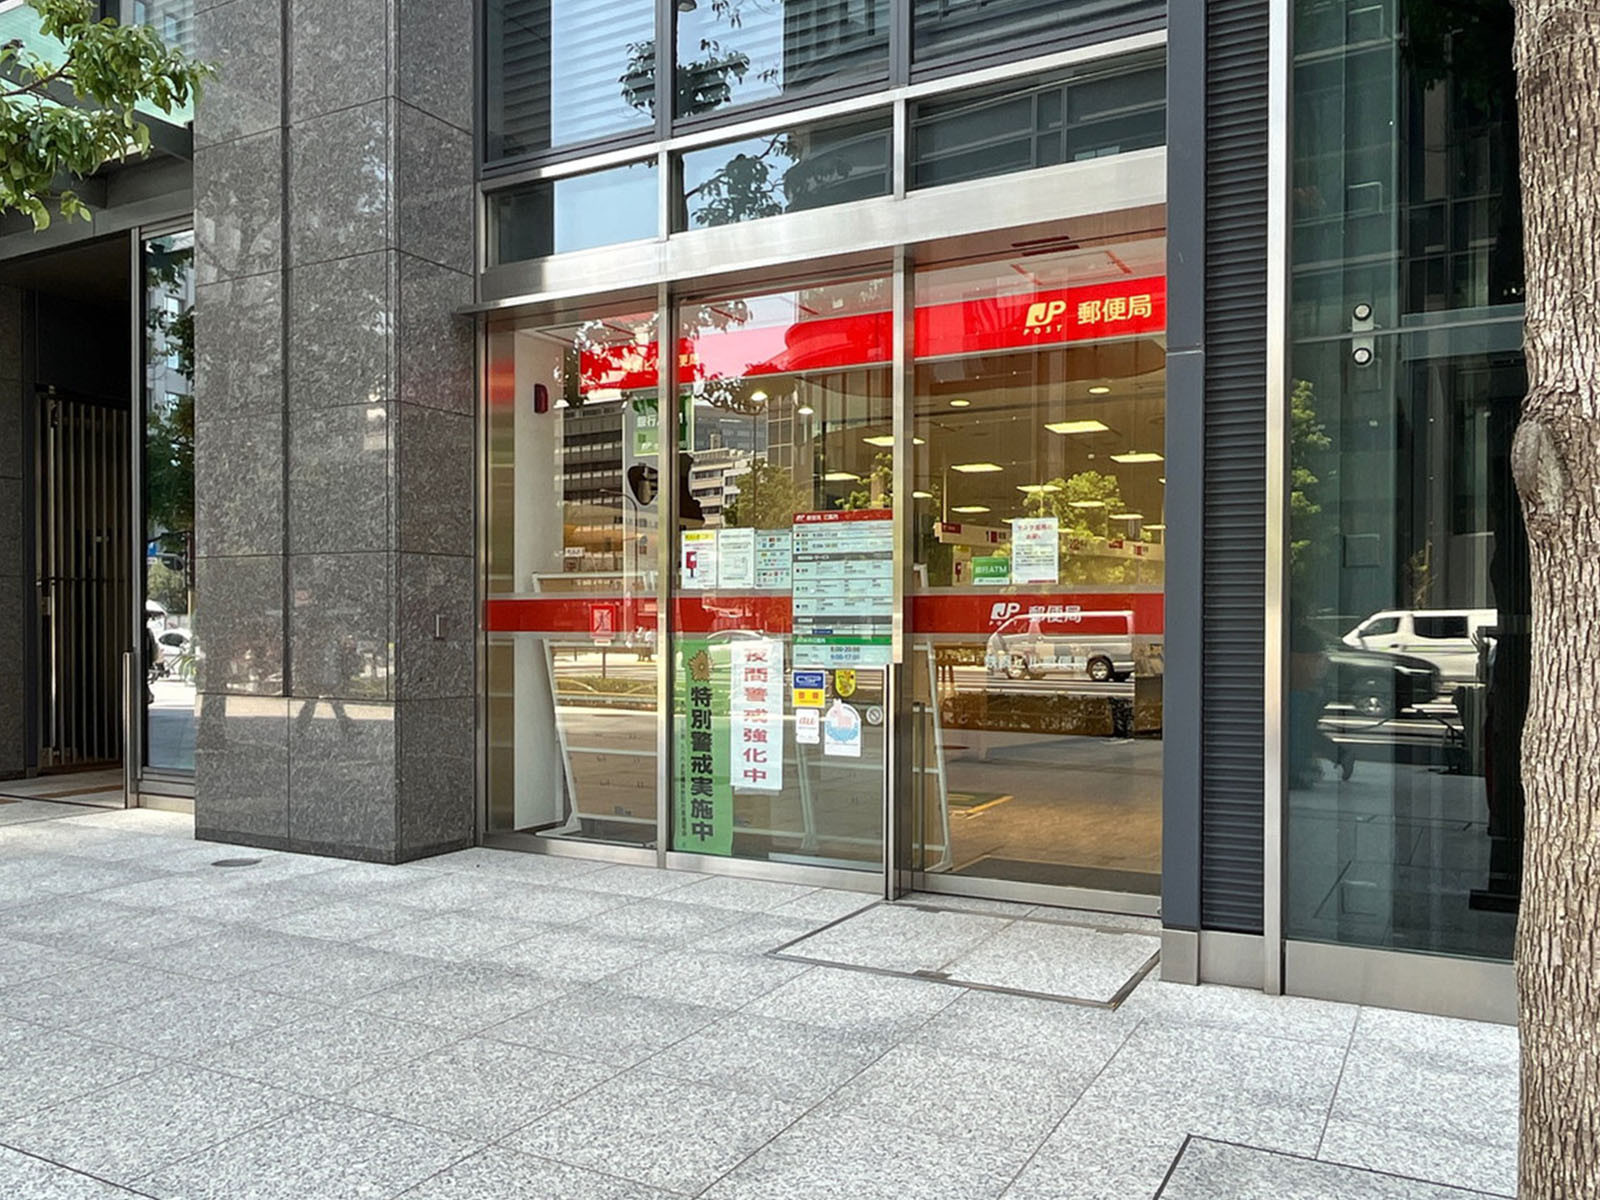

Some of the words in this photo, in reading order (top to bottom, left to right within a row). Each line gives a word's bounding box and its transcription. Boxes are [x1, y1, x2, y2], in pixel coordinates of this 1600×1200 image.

[1025, 301, 1067, 327] JP
[1077, 294, 1152, 325] 郵便局
[1023, 324, 1062, 336] POST
[990, 602, 1021, 620] JP
[1028, 605, 1083, 623] 郵便局
[690, 686, 714, 842] 特別警戒実施中
